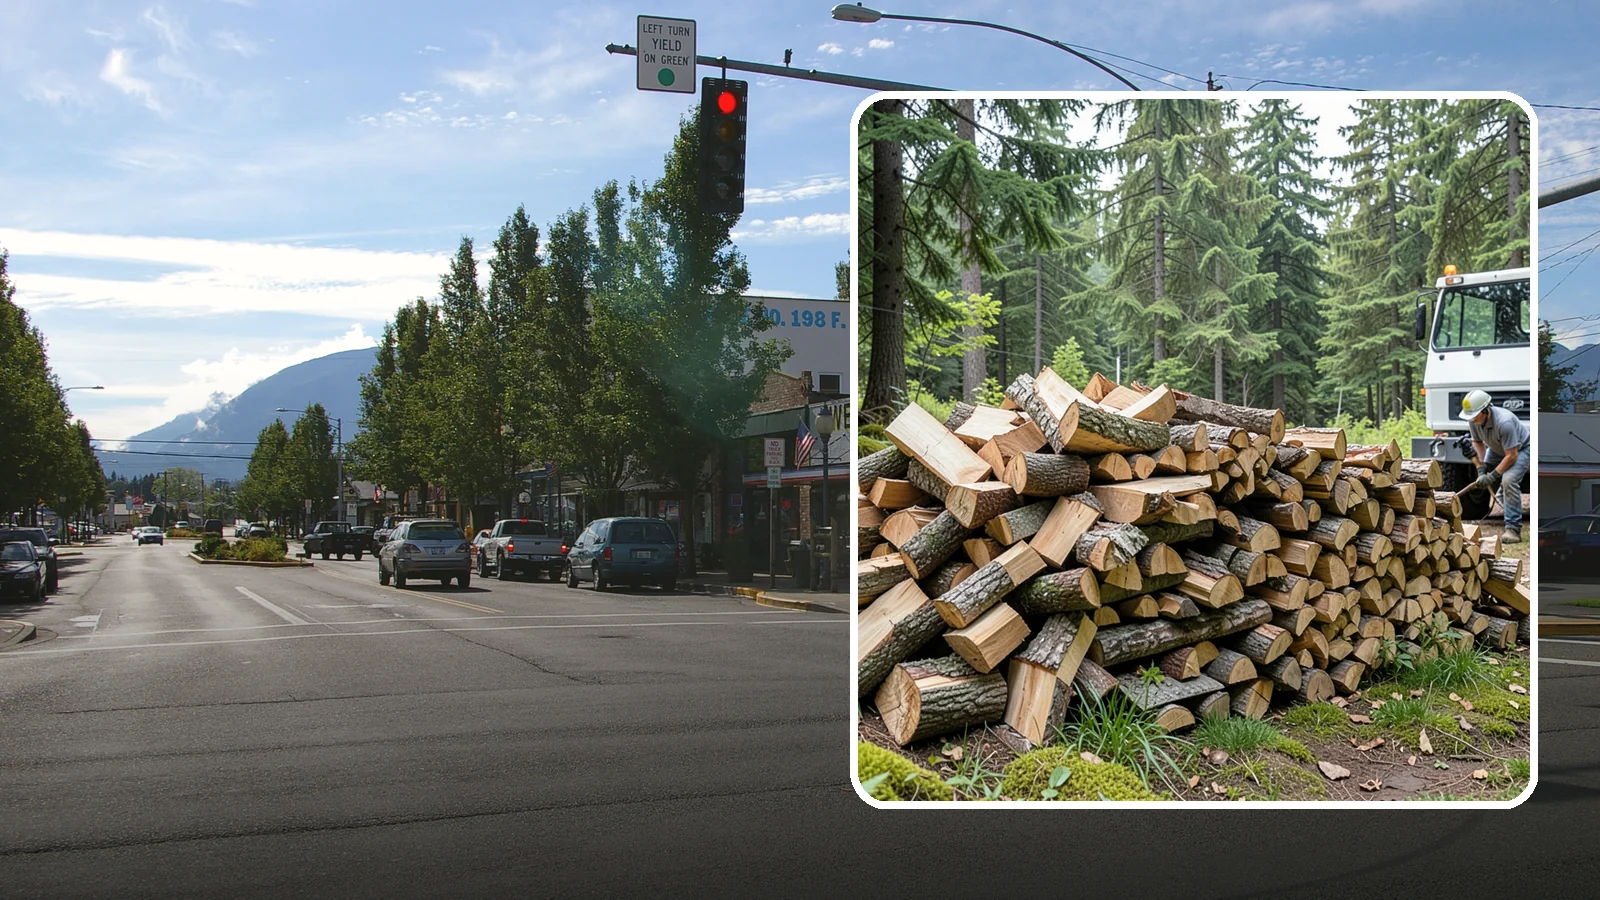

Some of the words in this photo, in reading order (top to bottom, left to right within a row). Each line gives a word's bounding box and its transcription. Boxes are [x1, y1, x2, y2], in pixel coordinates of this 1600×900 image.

[643, 23, 663, 34] LEFT
[668, 25, 690, 36] TURN
[652, 38, 682, 52] YIELD
[644, 53, 656, 64] ON
[661, 54, 689, 66] GREEN
[791, 309, 826, 328] 198
[831, 311, 847, 329] F.
